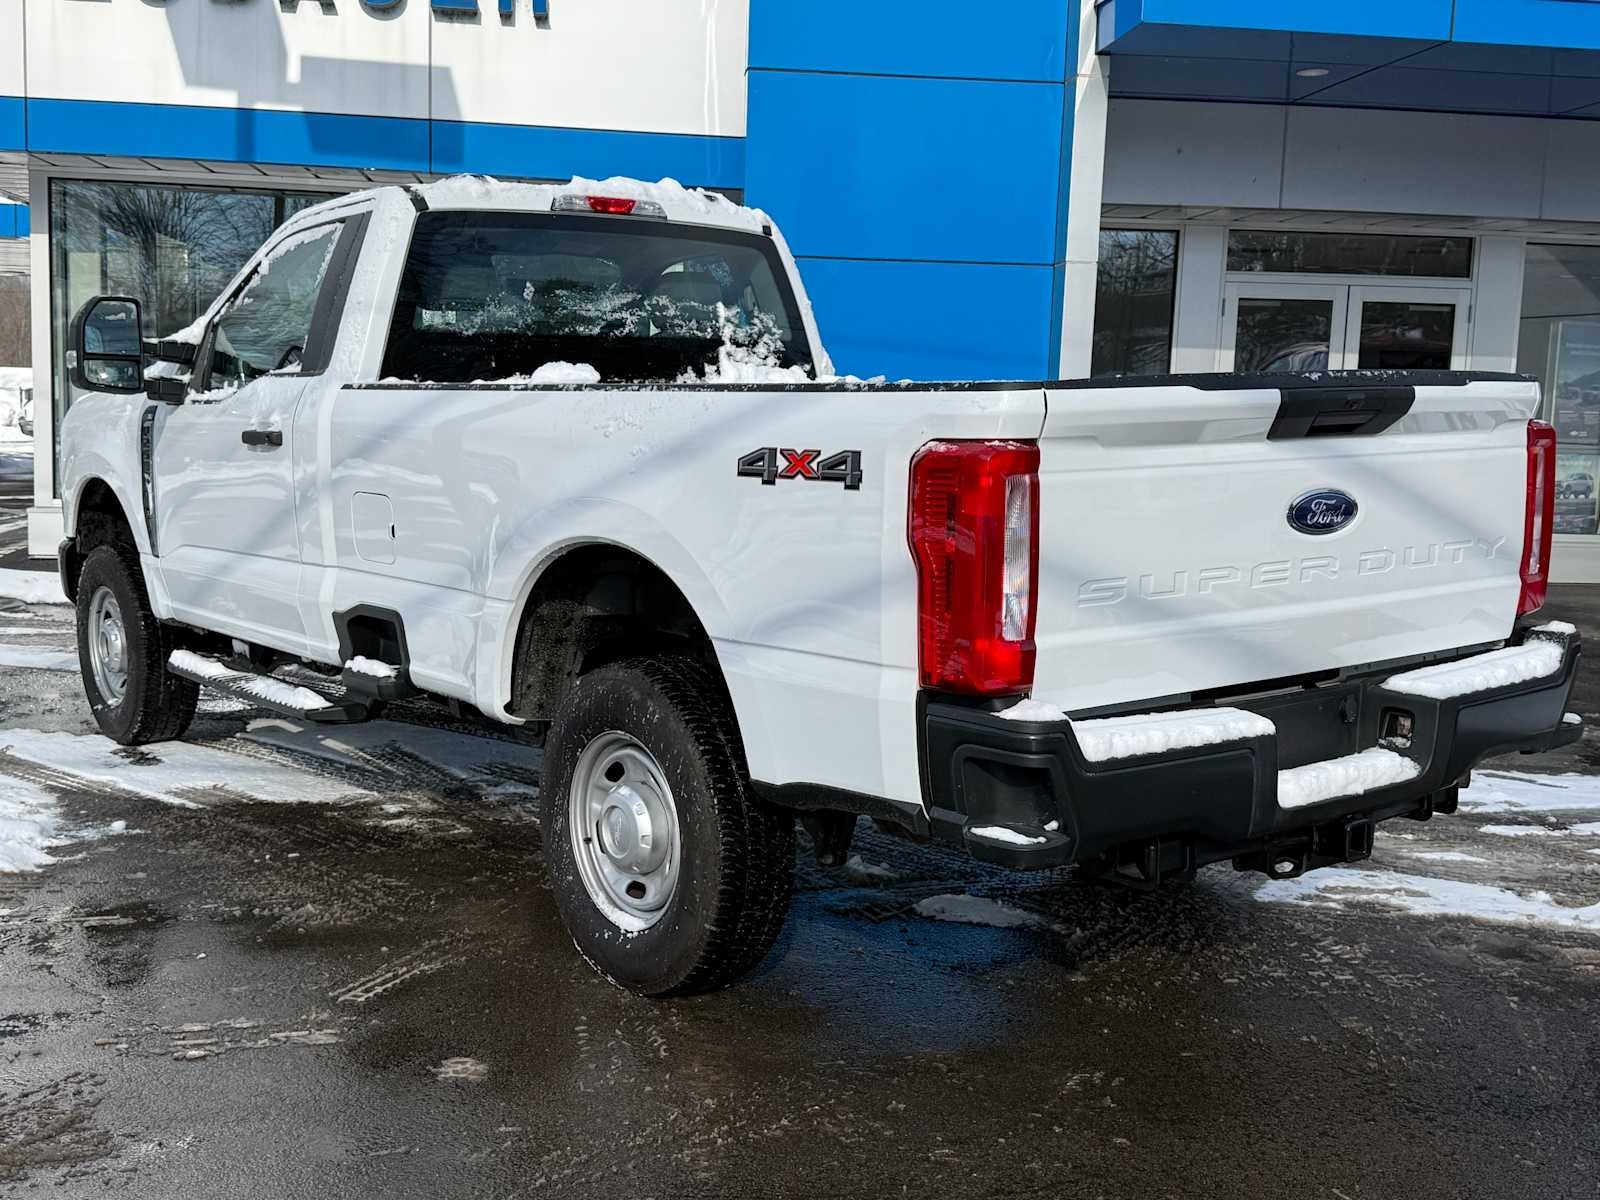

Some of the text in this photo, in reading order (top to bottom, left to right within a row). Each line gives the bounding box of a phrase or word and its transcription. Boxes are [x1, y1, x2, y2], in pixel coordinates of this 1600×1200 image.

[1306, 499, 1345, 524] Ford
[1078, 535, 1506, 608] SUPER DUTY
